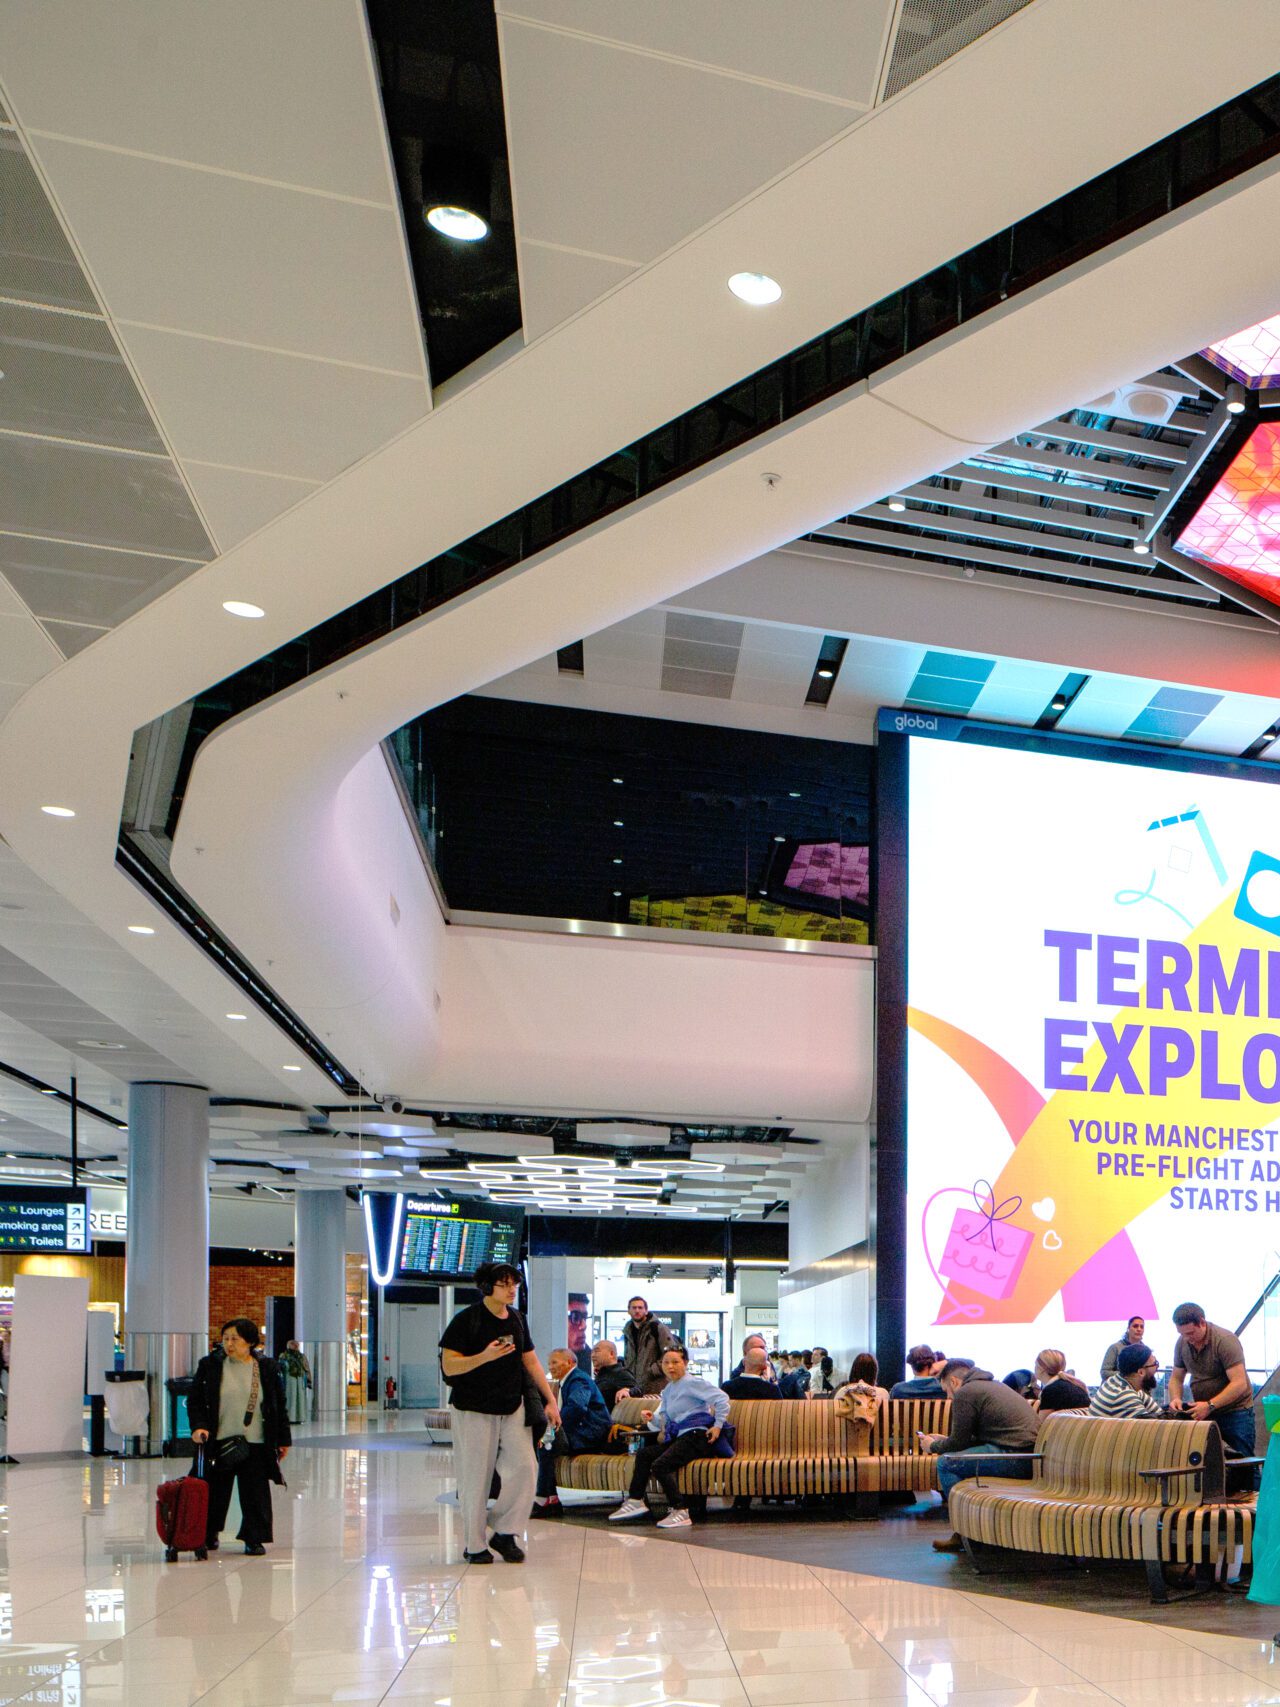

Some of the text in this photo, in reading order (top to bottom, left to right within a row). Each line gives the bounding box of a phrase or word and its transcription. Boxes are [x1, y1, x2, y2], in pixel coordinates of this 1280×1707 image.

[895, 713, 937, 731] global
[1069, 1119, 1138, 1146] YOUR
[1097, 1152, 1244, 1182] PRE-FLIGHT
[408, 1200, 451, 1213] Departures
[1170, 1186, 1258, 1212] STARTS
[20, 1205, 65, 1217] Lounges
[41, 1223, 64, 1231] area
[29, 1236, 64, 1246] Toilets
